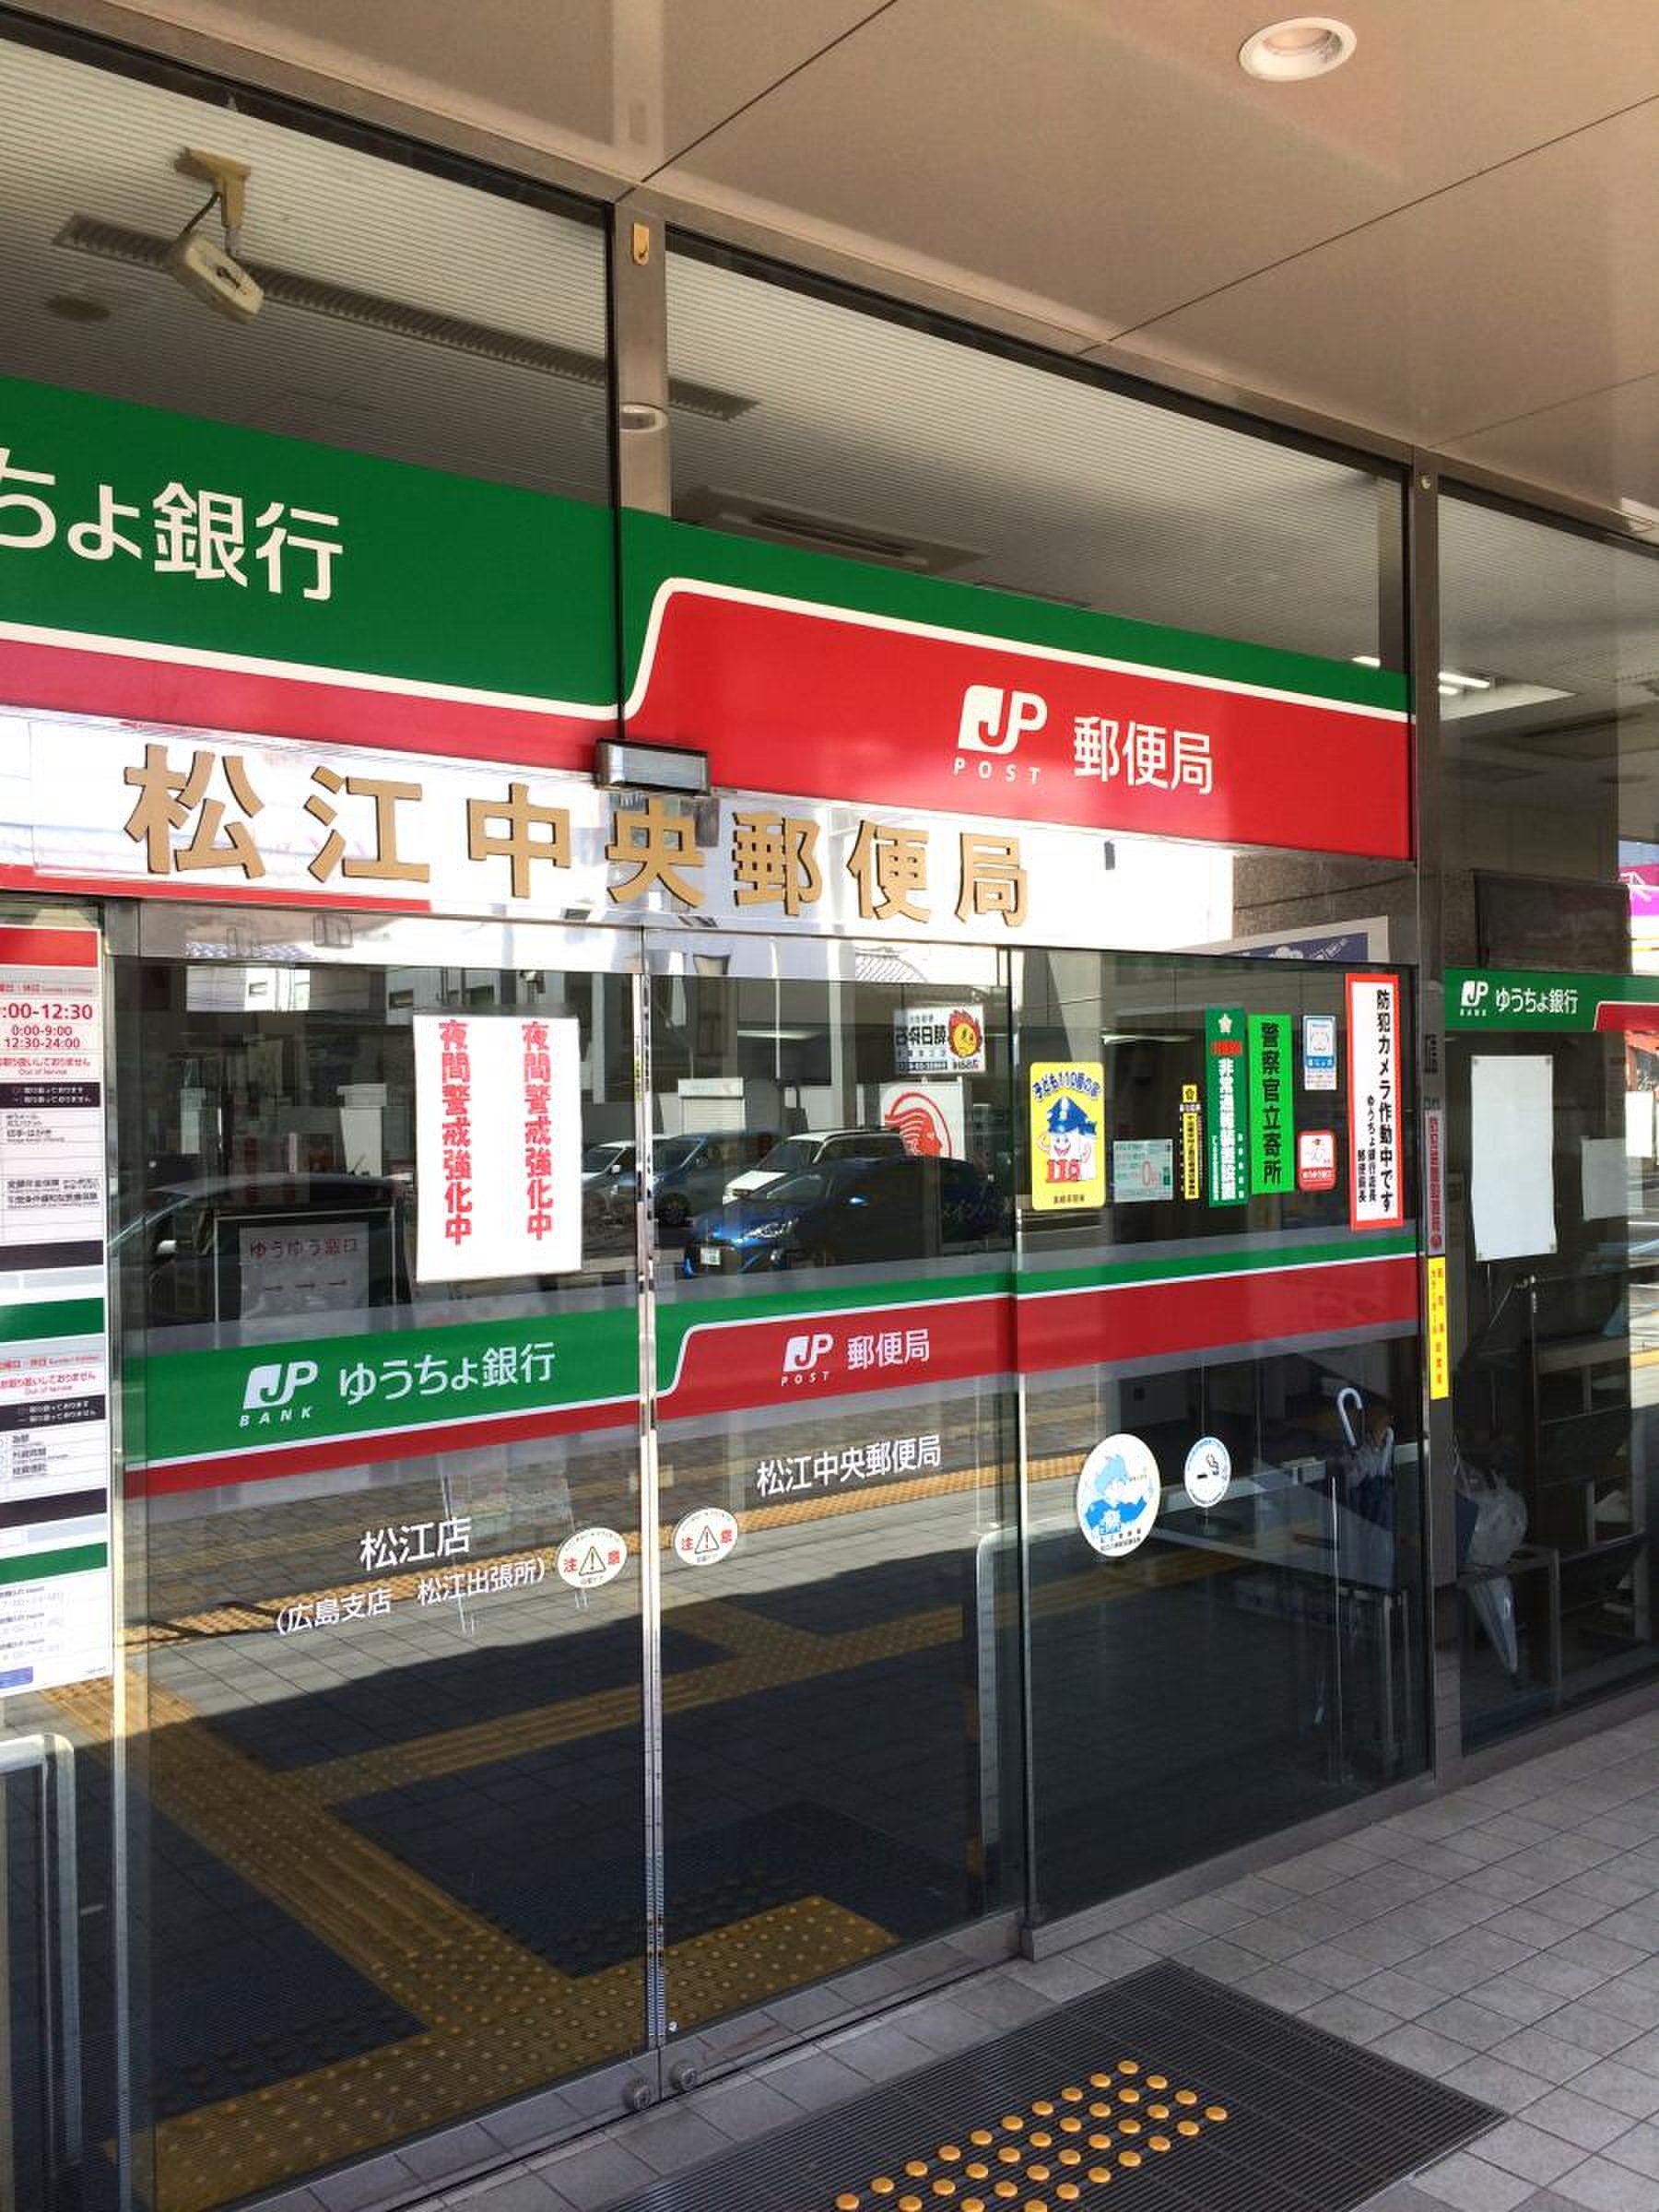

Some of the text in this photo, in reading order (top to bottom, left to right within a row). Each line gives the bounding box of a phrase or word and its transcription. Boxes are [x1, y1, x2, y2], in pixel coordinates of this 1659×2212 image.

[958, 685, 1048, 755] JP
[953, 757, 1041, 785] POST
[1073, 715, 1214, 794] 郵便局
[124, 743, 1030, 928] 松江中央郵便局
[0, 1003, 93, 1019] :00-12:30
[1495, 987, 1579, 1015] ゆうちょ銀行
[5, 1038, 80, 1048] 12:30-24:00
[12, 1025, 73, 1036] 0:00-9:00
[1261, 1021, 1283, 1185] 警察官立寄所
[1376, 989, 1394, 1214] 防犯カメラ作動中です
[439, 1018, 473, 1246] 夜間警戒強化中
[521, 1021, 554, 1241] 夜間警戒強化中
[339, 1341, 557, 1406] ゆうちょ銀行
[783, 1334, 834, 1372] JP
[847, 1328, 931, 1371] 郵便局
[243, 1360, 318, 1410] JP
[781, 1371, 832, 1387] POST
[239, 1406, 314, 1429] BANK
[757, 1434, 942, 1498] 松江中央郵便局
[359, 1517, 473, 1572] 松江店
[276, 1557, 546, 1636] (広島支店 松江出張所)
